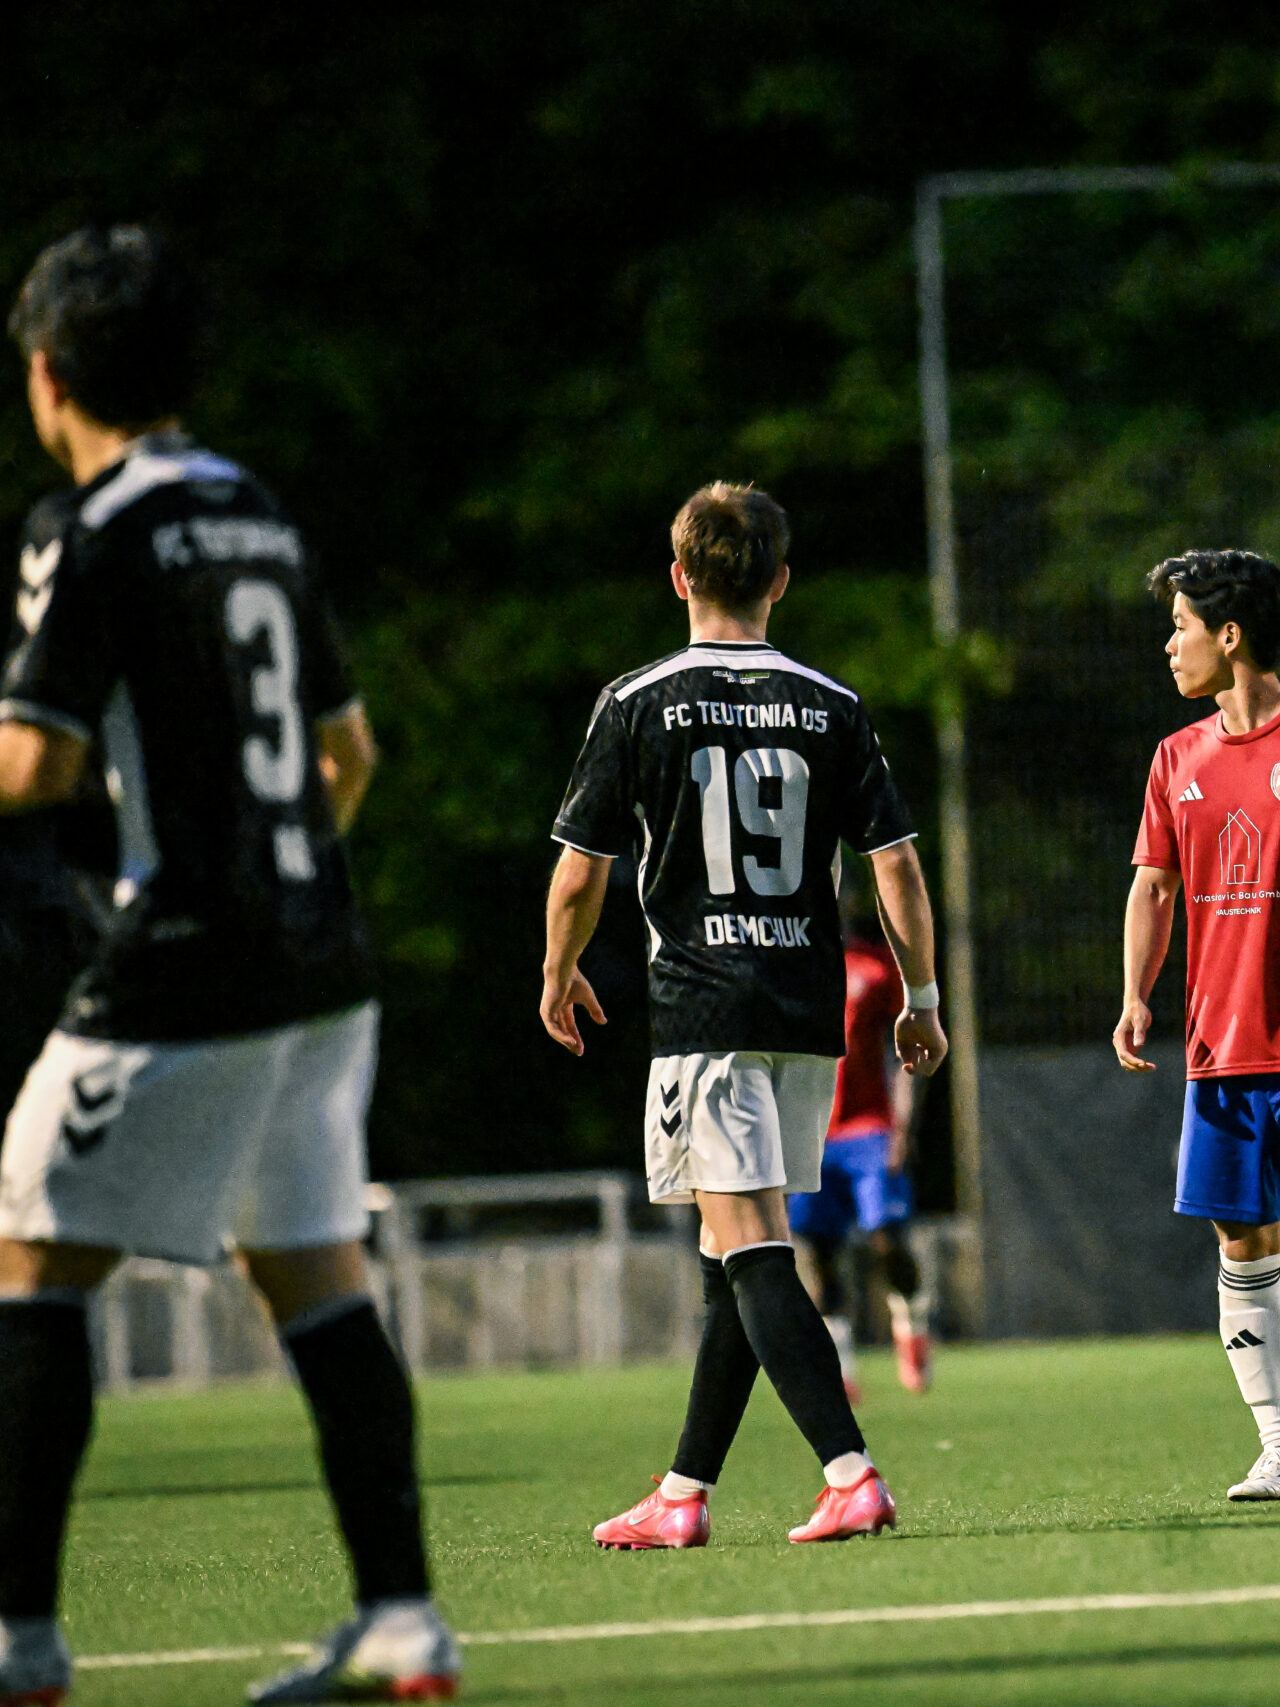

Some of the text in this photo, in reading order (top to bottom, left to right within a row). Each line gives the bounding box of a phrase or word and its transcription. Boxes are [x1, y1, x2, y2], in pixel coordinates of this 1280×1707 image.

[226, 580, 305, 800] 3
[663, 701, 828, 733] FC TEUTONIA 05
[691, 746, 810, 896] 19
[1216, 906, 1261, 916] HAUSTECHNIK
[1238, 891, 1257, 900] Bau
